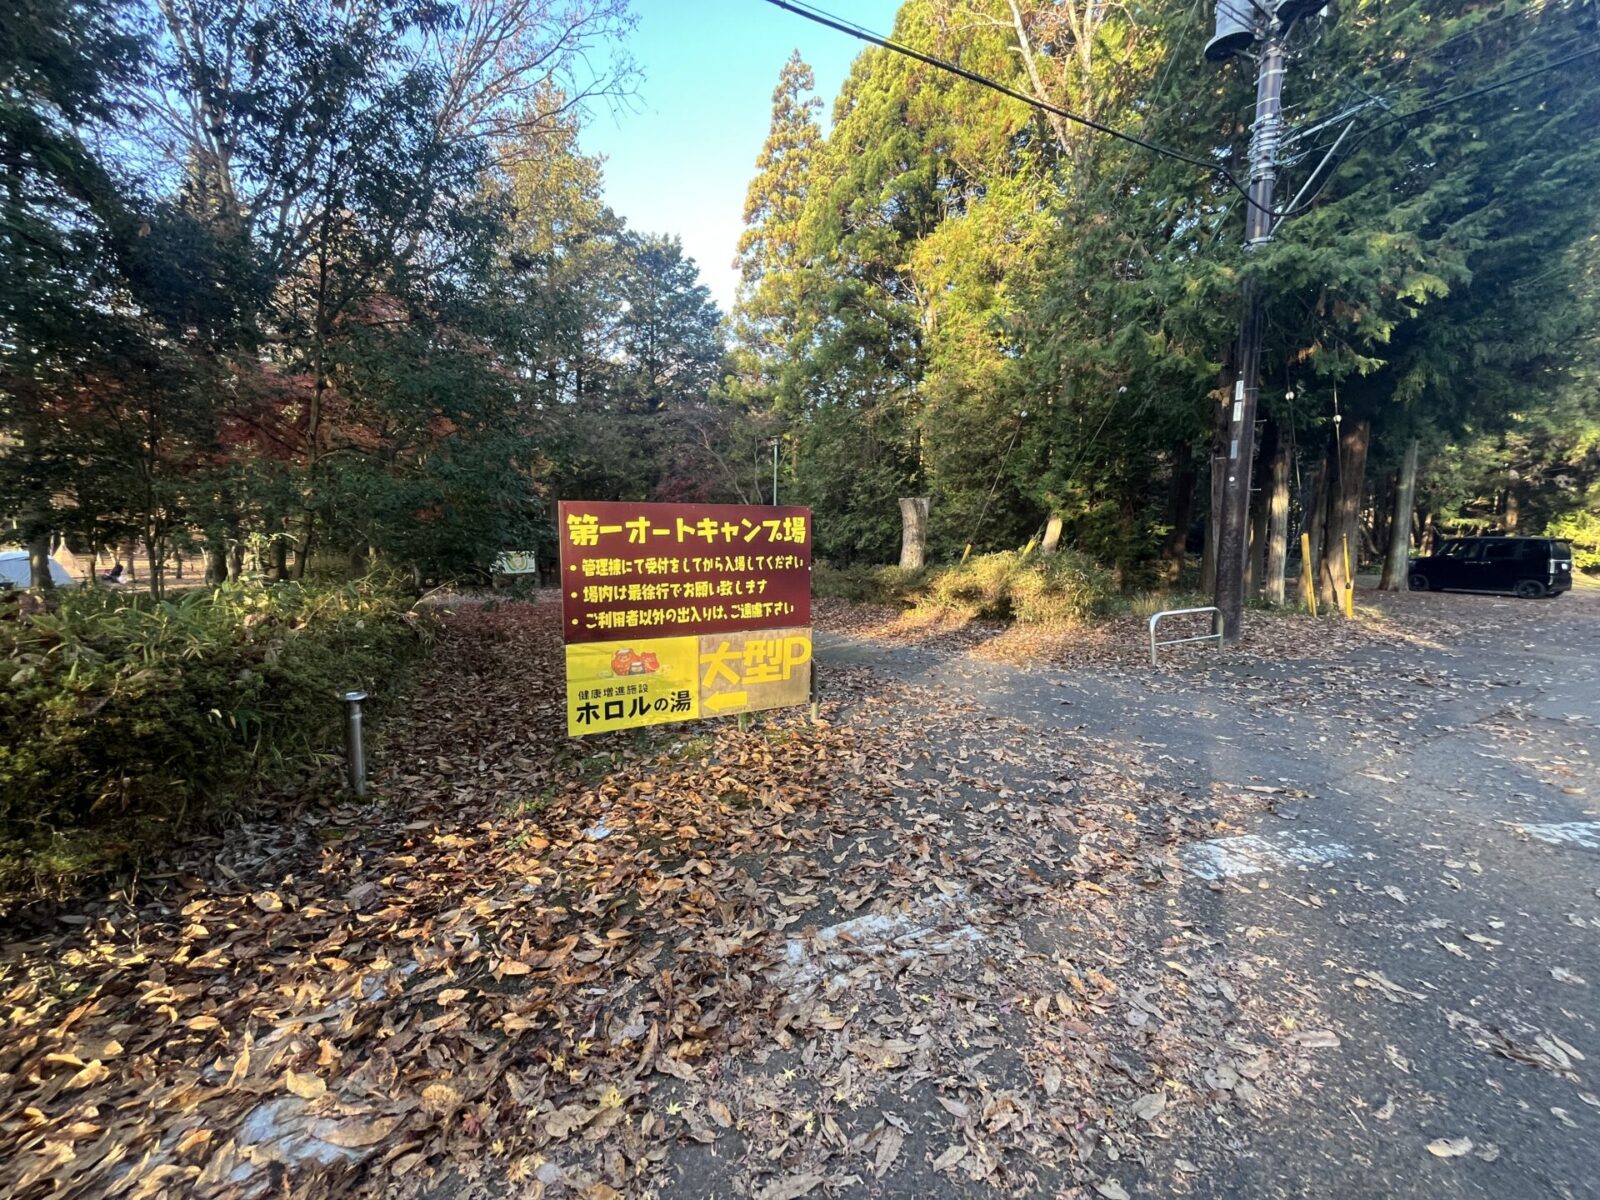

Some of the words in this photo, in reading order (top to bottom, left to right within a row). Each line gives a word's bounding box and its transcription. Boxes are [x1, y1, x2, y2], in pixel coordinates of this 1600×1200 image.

[567, 513, 807, 546] 第一オートキャンプ場
[700, 636, 812, 688] 大型P
[576, 690, 692, 725] ホロルの湯
[578, 684, 649, 701] 健康増進施設
